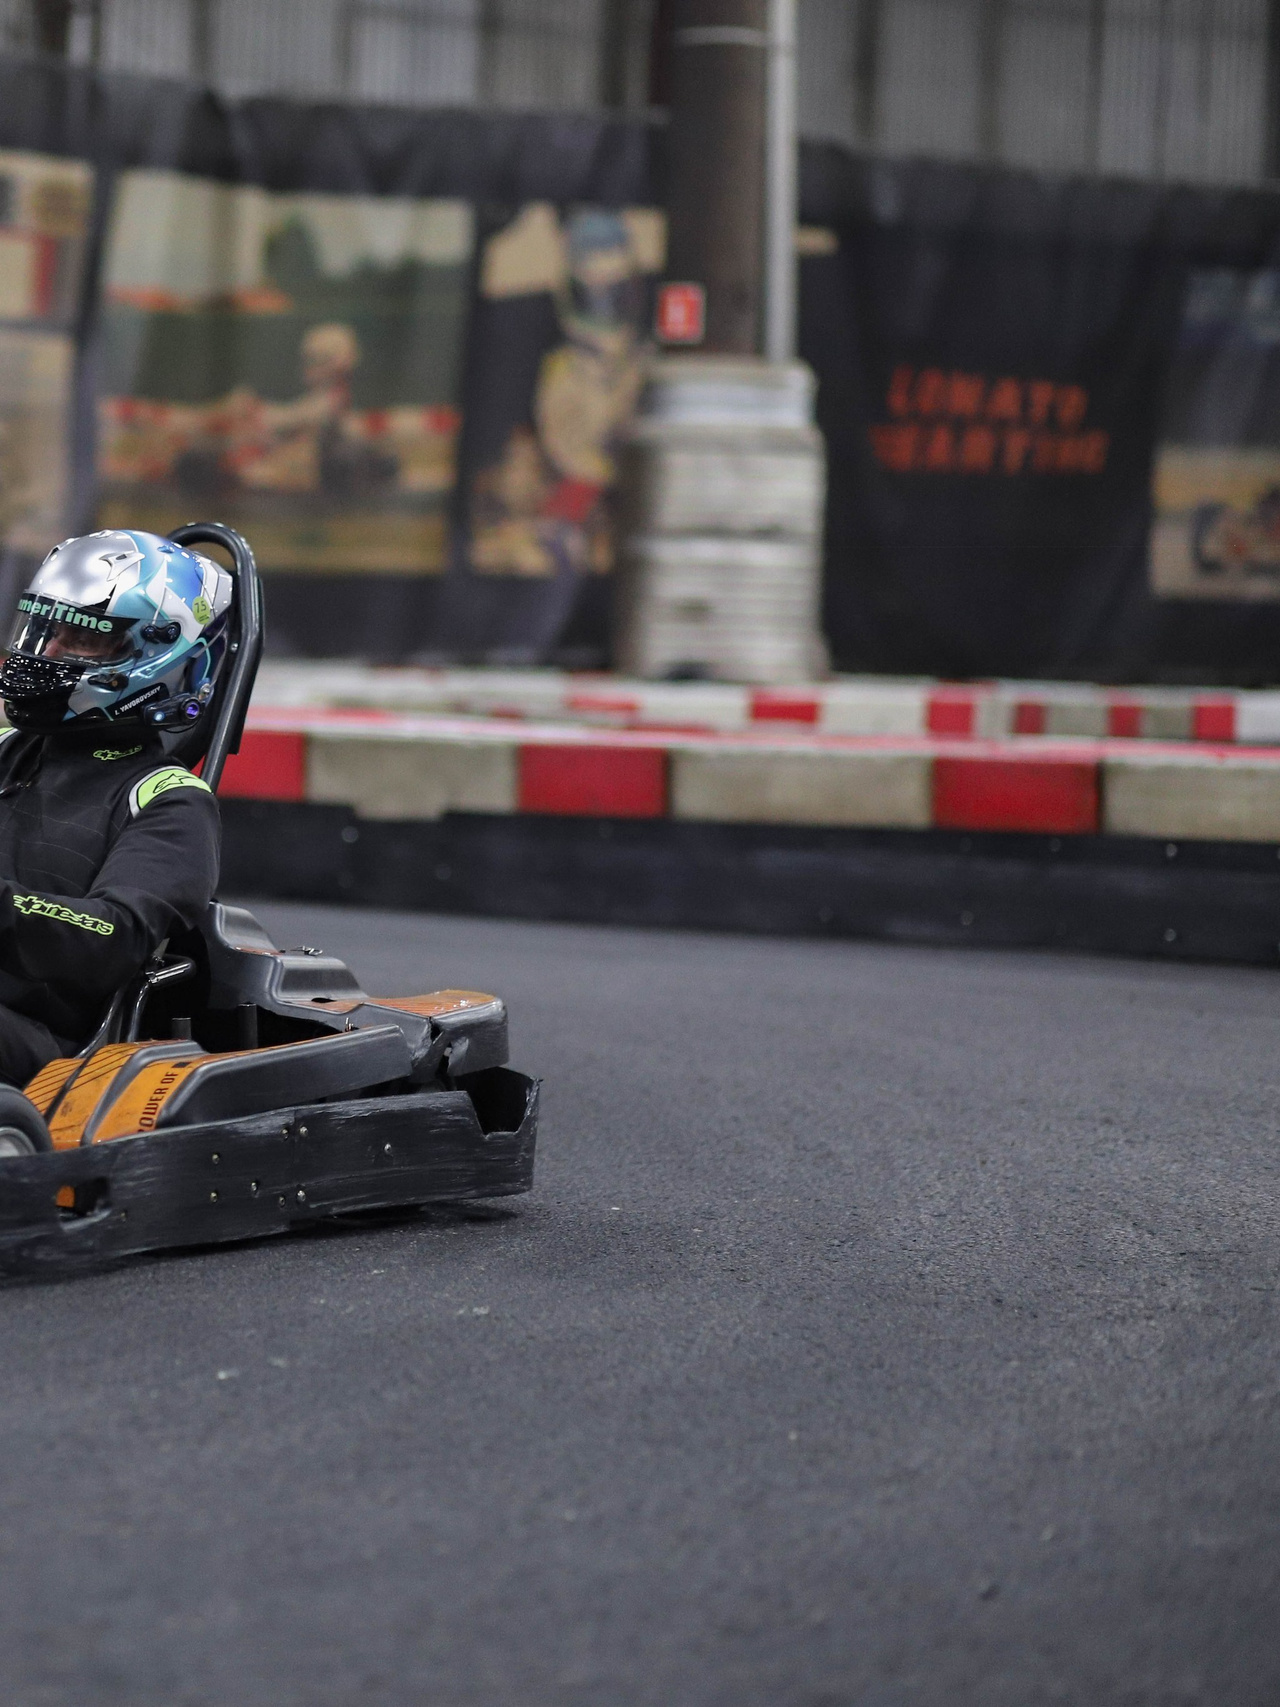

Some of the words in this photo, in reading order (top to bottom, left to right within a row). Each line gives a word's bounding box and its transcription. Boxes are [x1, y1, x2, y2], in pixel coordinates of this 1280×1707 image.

[886, 363, 1088, 430] LONATO
[55, 603, 113, 633] Time
[137, 1087, 169, 1133] OWER
[160, 1071, 179, 1084] OF
